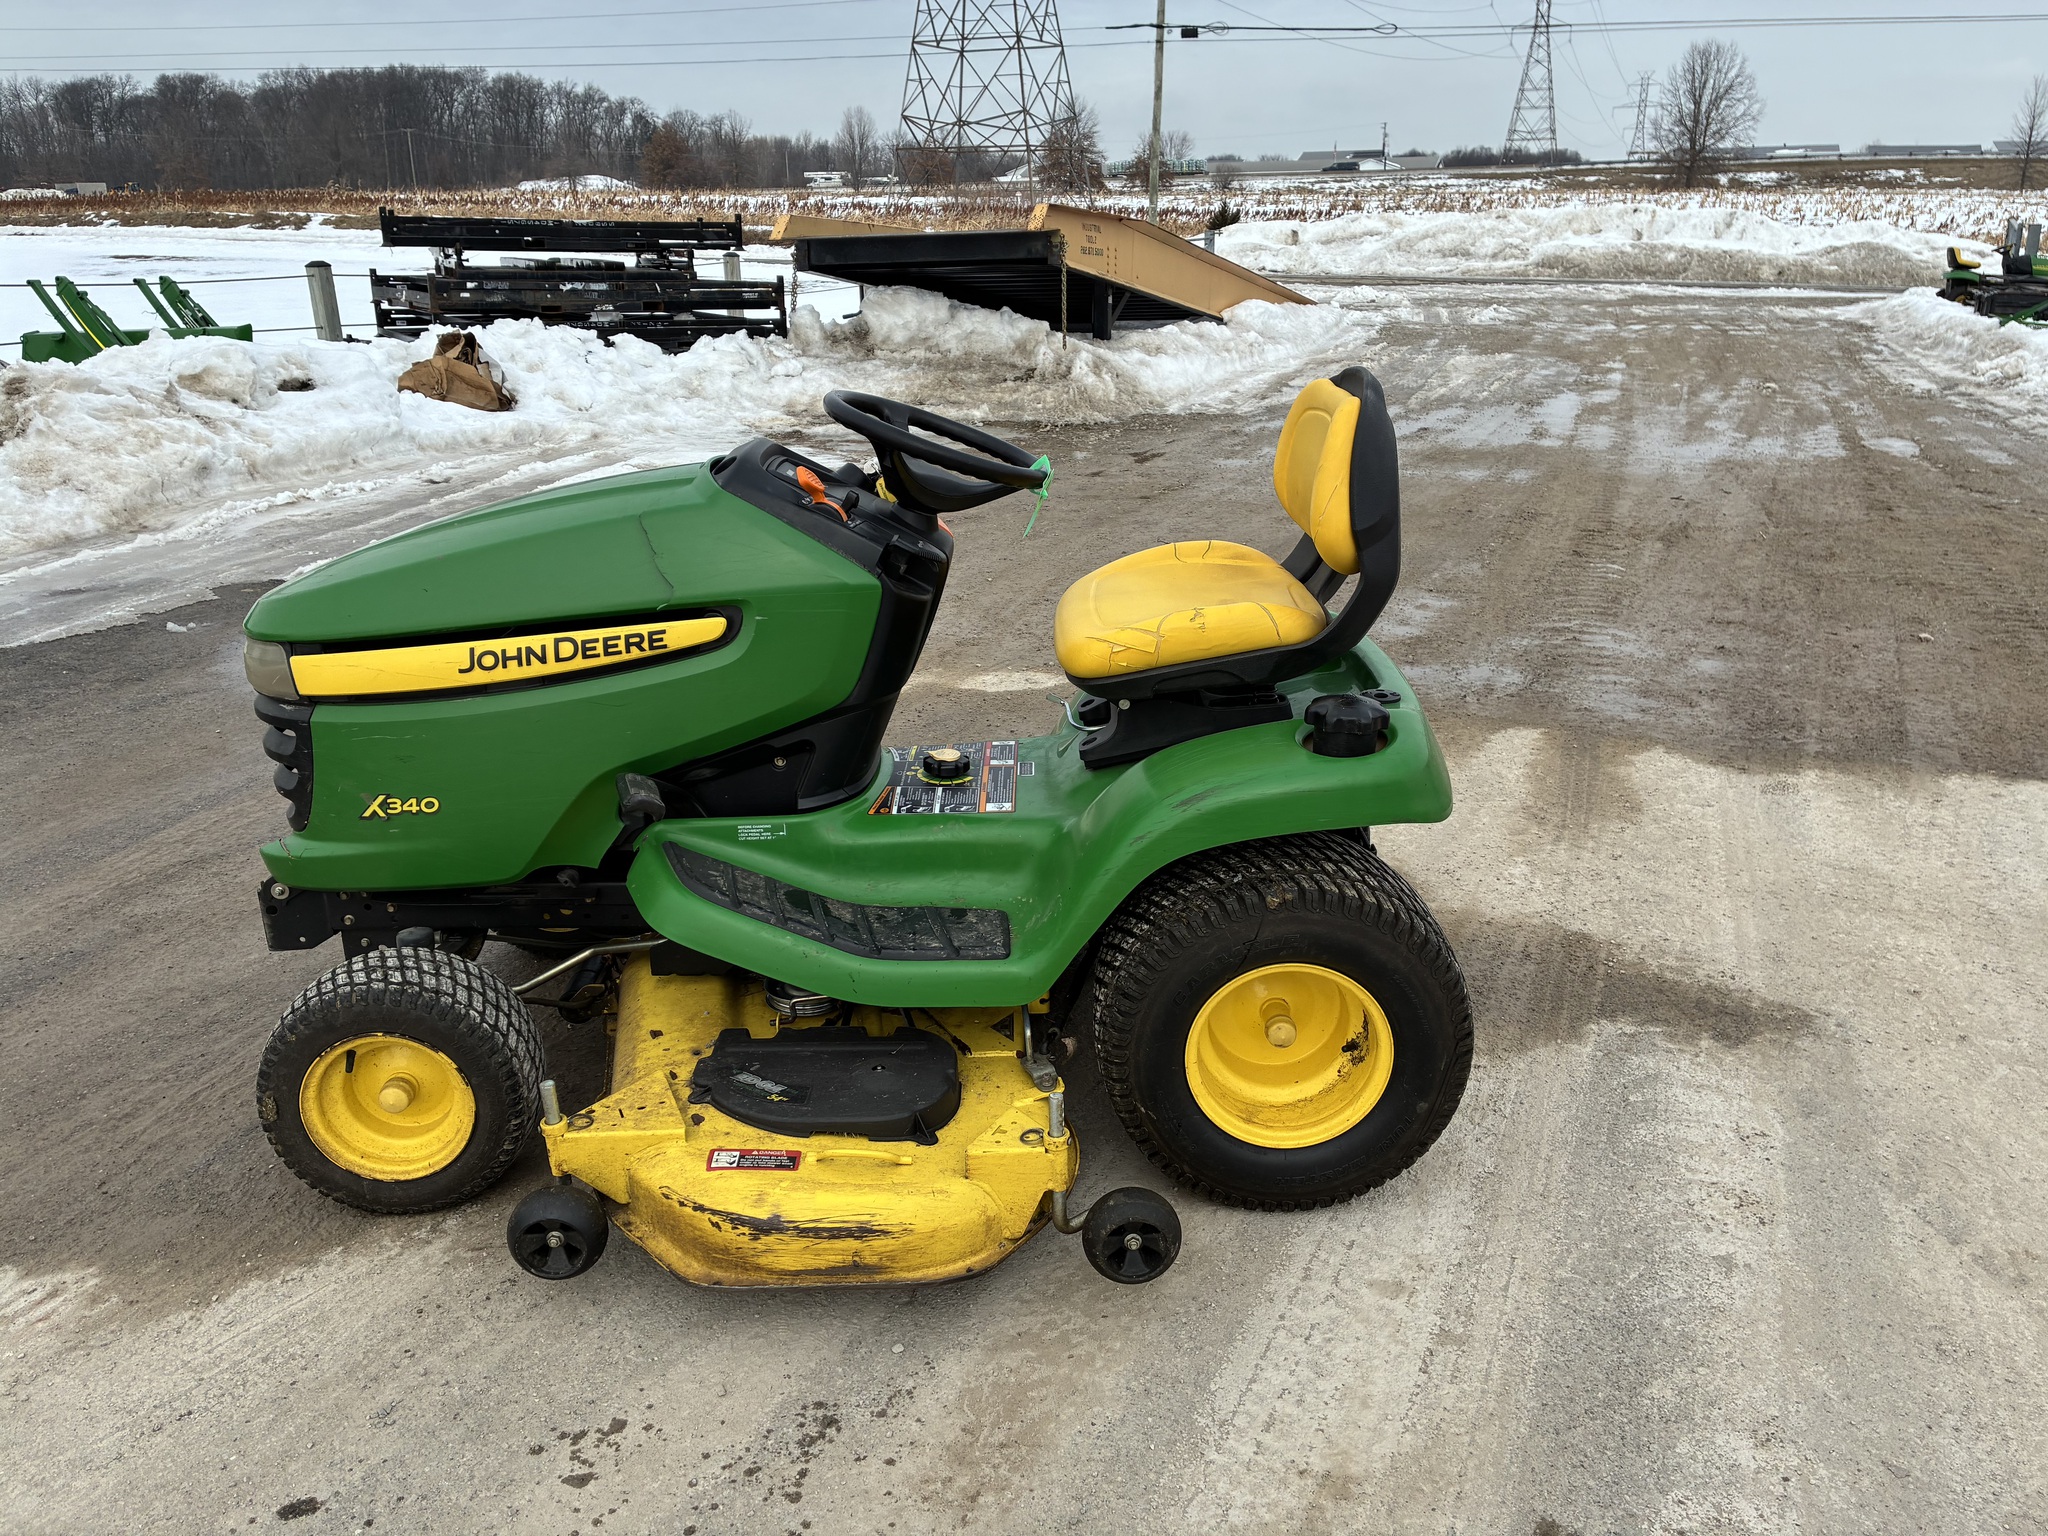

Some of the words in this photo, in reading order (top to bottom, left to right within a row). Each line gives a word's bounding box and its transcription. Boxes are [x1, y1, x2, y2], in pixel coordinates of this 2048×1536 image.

[458, 644, 547, 674] JOHN
[553, 629, 668, 663] DEERE
[359, 793, 441, 820] X340
[730, 1071, 788, 1093] EDGE
